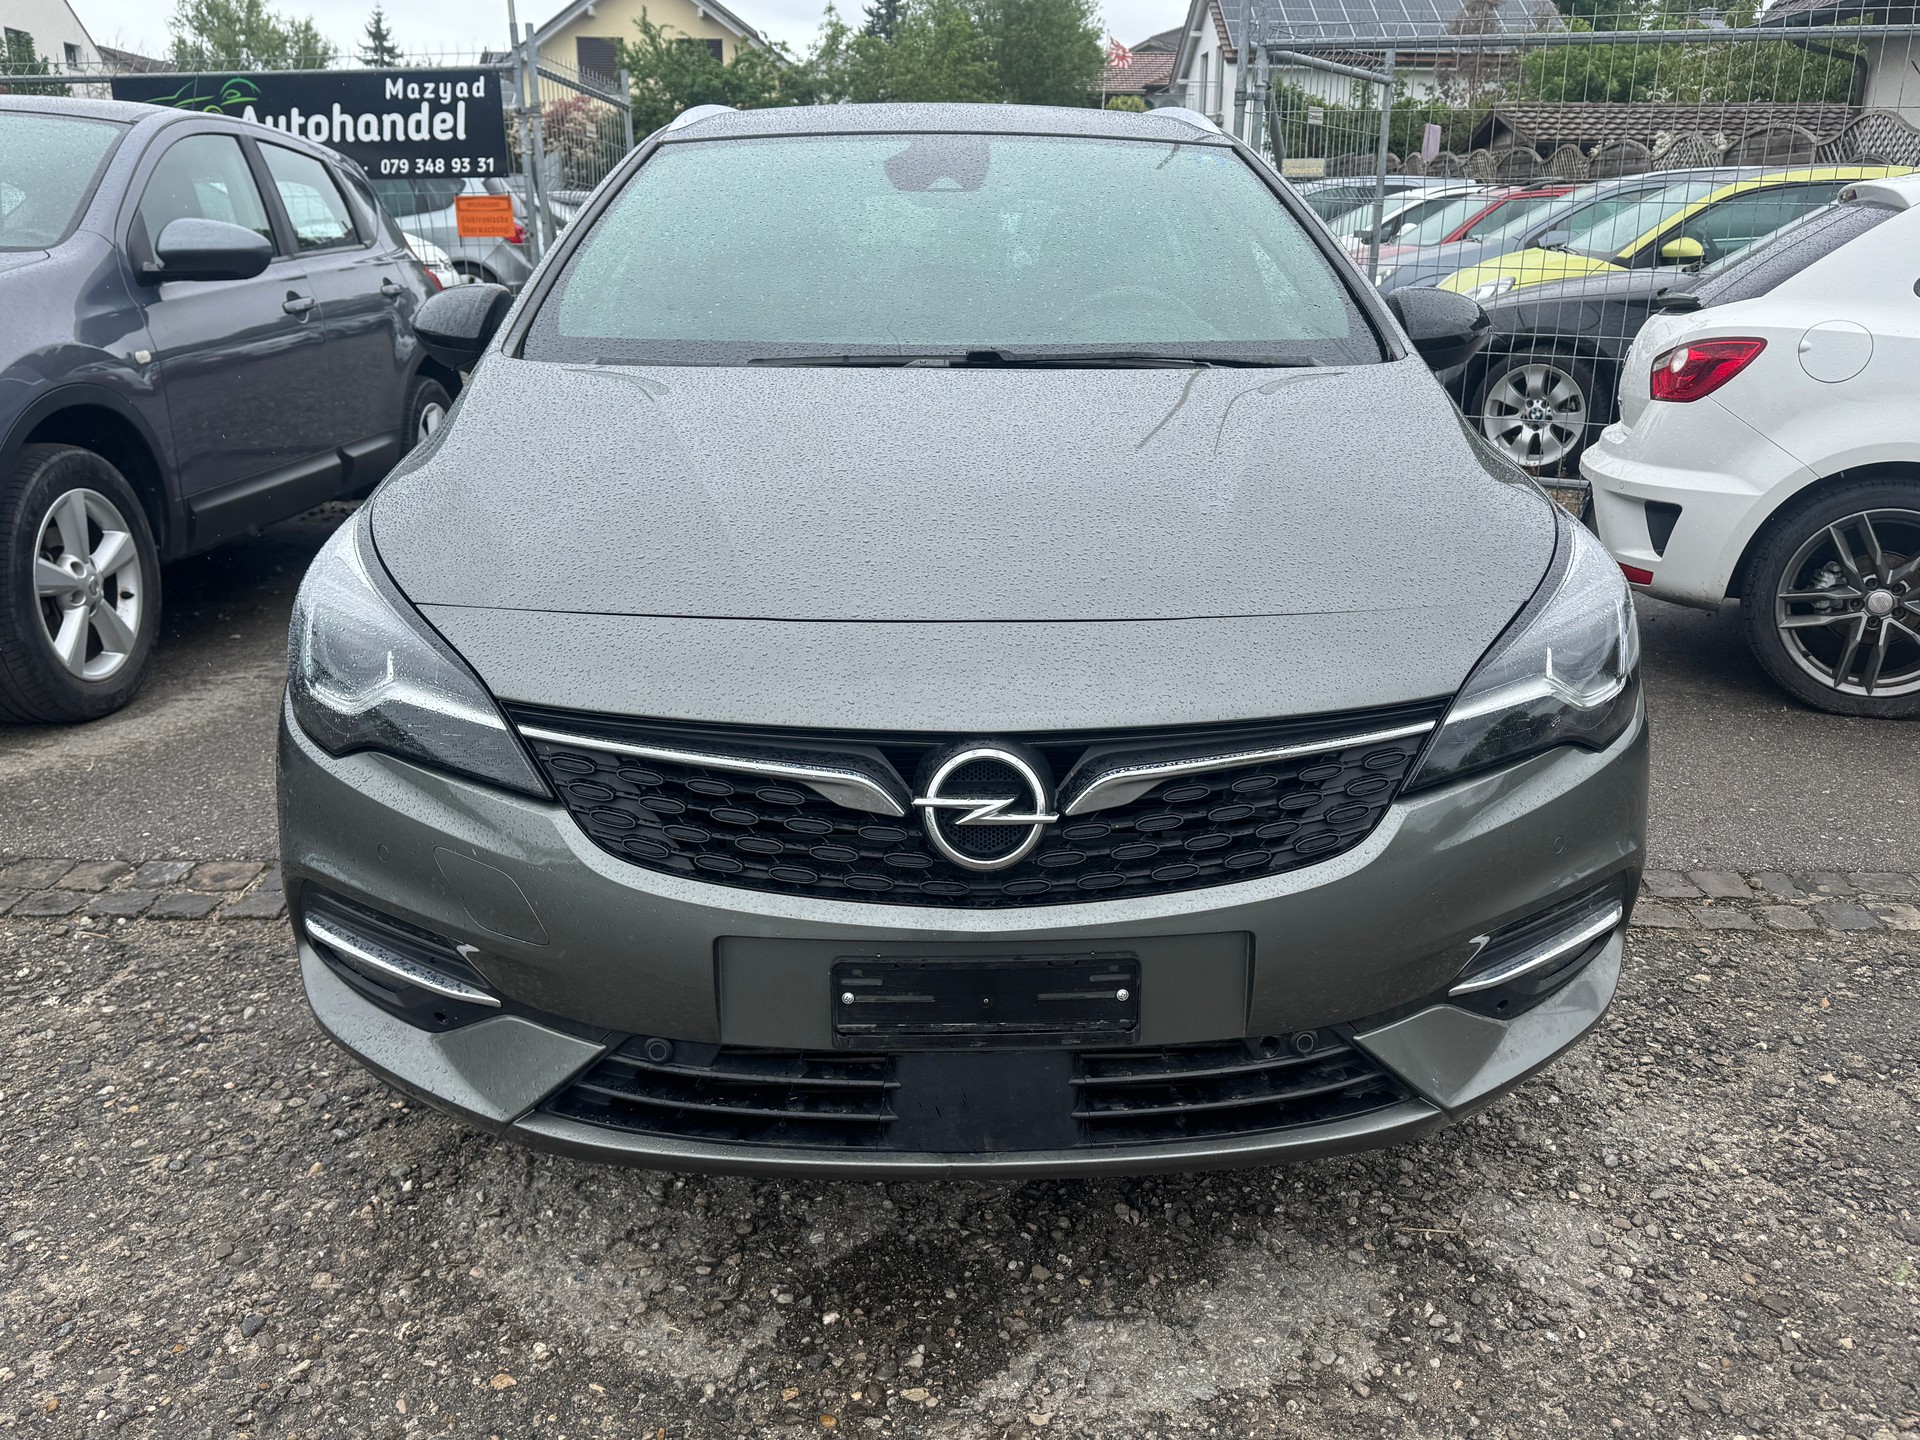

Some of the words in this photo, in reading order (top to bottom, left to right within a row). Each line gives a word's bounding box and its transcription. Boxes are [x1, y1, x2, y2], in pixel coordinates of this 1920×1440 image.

[385, 75, 485, 105] Mazyad
[242, 100, 467, 143] Autohandel
[381, 158, 409, 174] 079
[415, 158, 445, 174] 348
[451, 157, 471, 173] 93
[477, 157, 494, 173] 31
